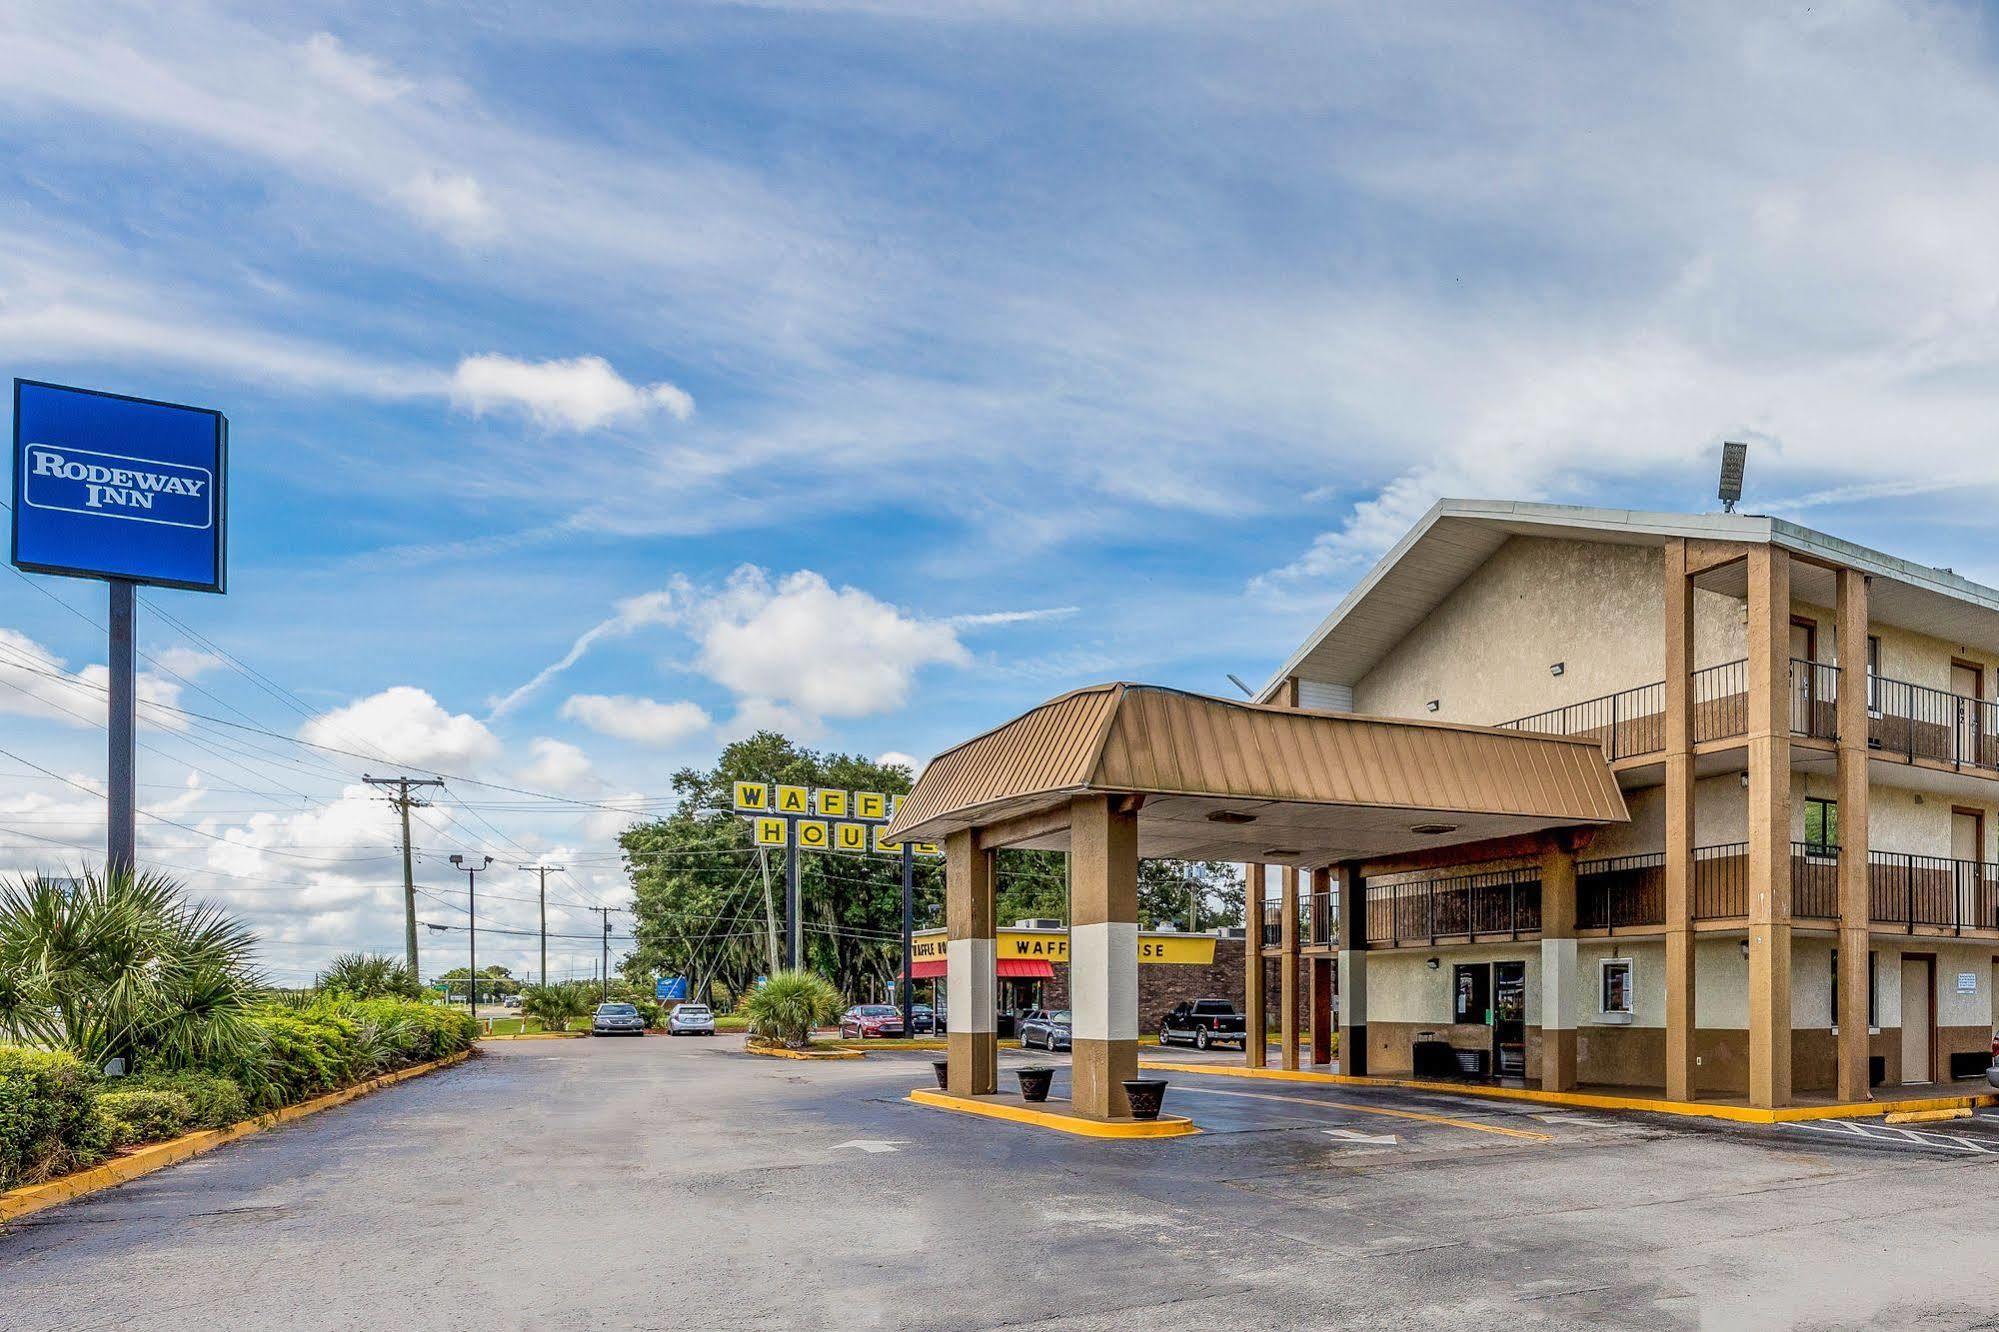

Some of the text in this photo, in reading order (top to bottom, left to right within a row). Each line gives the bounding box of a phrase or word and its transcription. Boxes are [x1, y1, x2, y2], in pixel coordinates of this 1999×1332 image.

[32, 451, 205, 497] RODEWAY
[86, 484, 154, 509] INN
[742, 787, 878, 814] WAFF
[764, 823, 935, 850] HOU
[1016, 941, 1067, 955] WAFF
